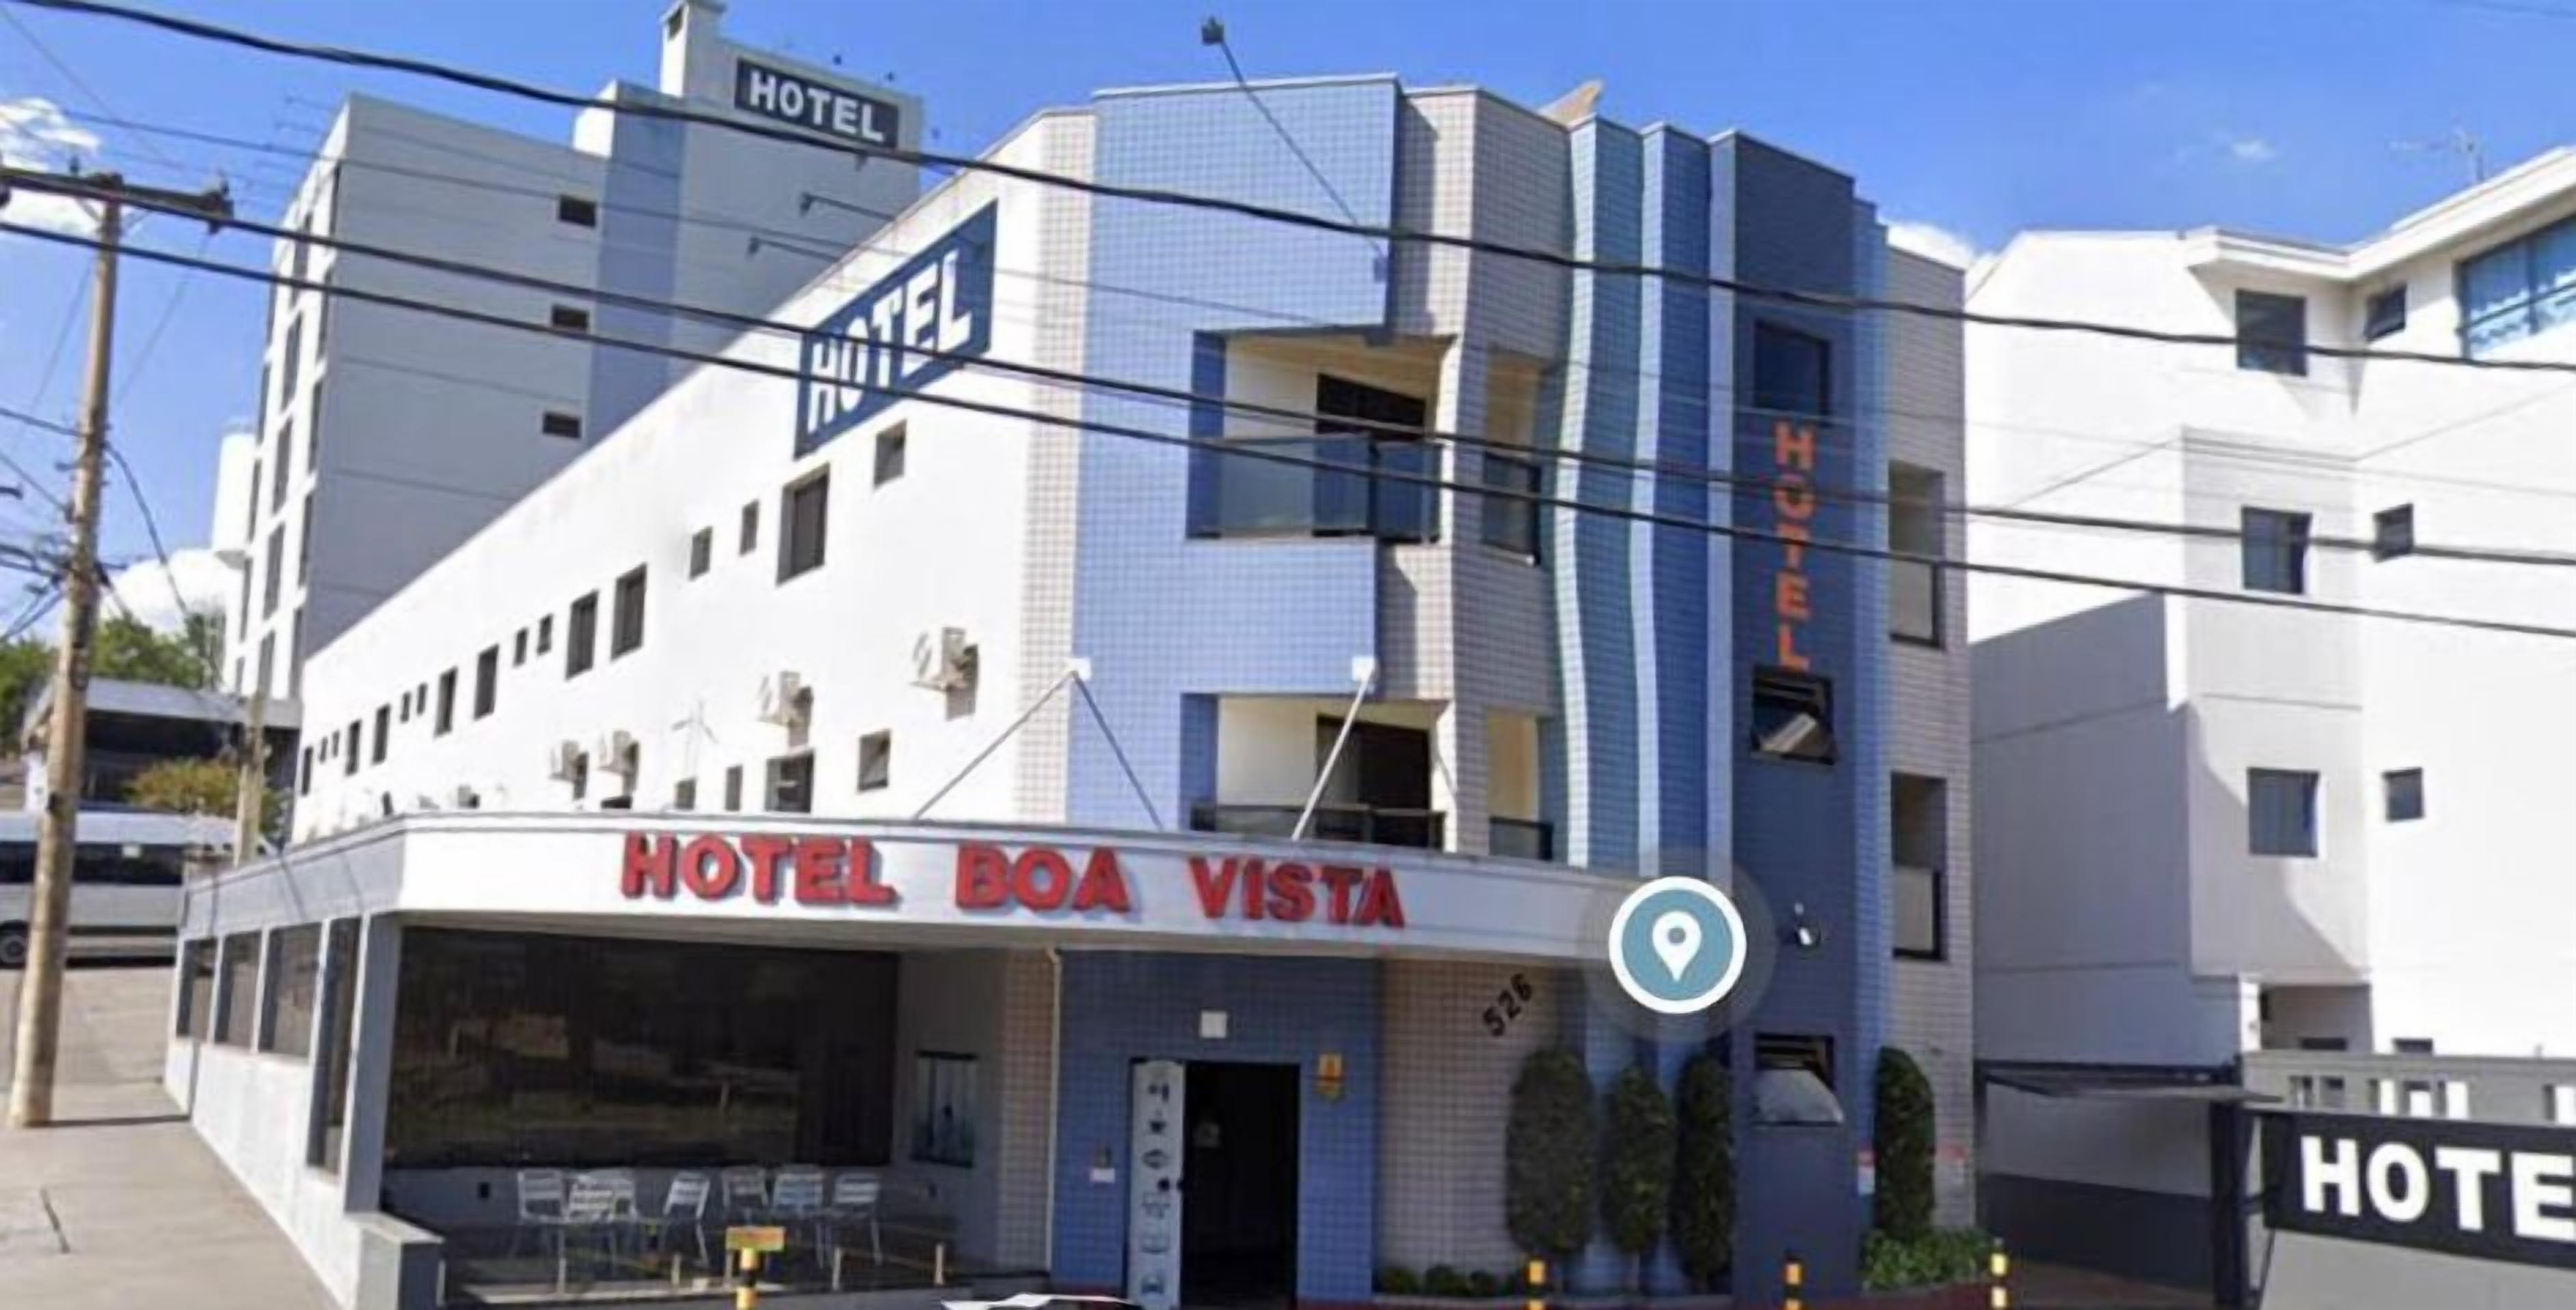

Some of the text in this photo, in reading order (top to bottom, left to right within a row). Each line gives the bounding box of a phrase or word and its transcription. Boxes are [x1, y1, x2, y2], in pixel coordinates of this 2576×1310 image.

[749, 70, 885, 142] HOTEL
[807, 248, 973, 435] HOTEL
[1772, 420, 1817, 671] HOTEL
[620, 832, 1406, 928] HOTEL BOA VISTA
[1482, 972, 1533, 1037] 526
